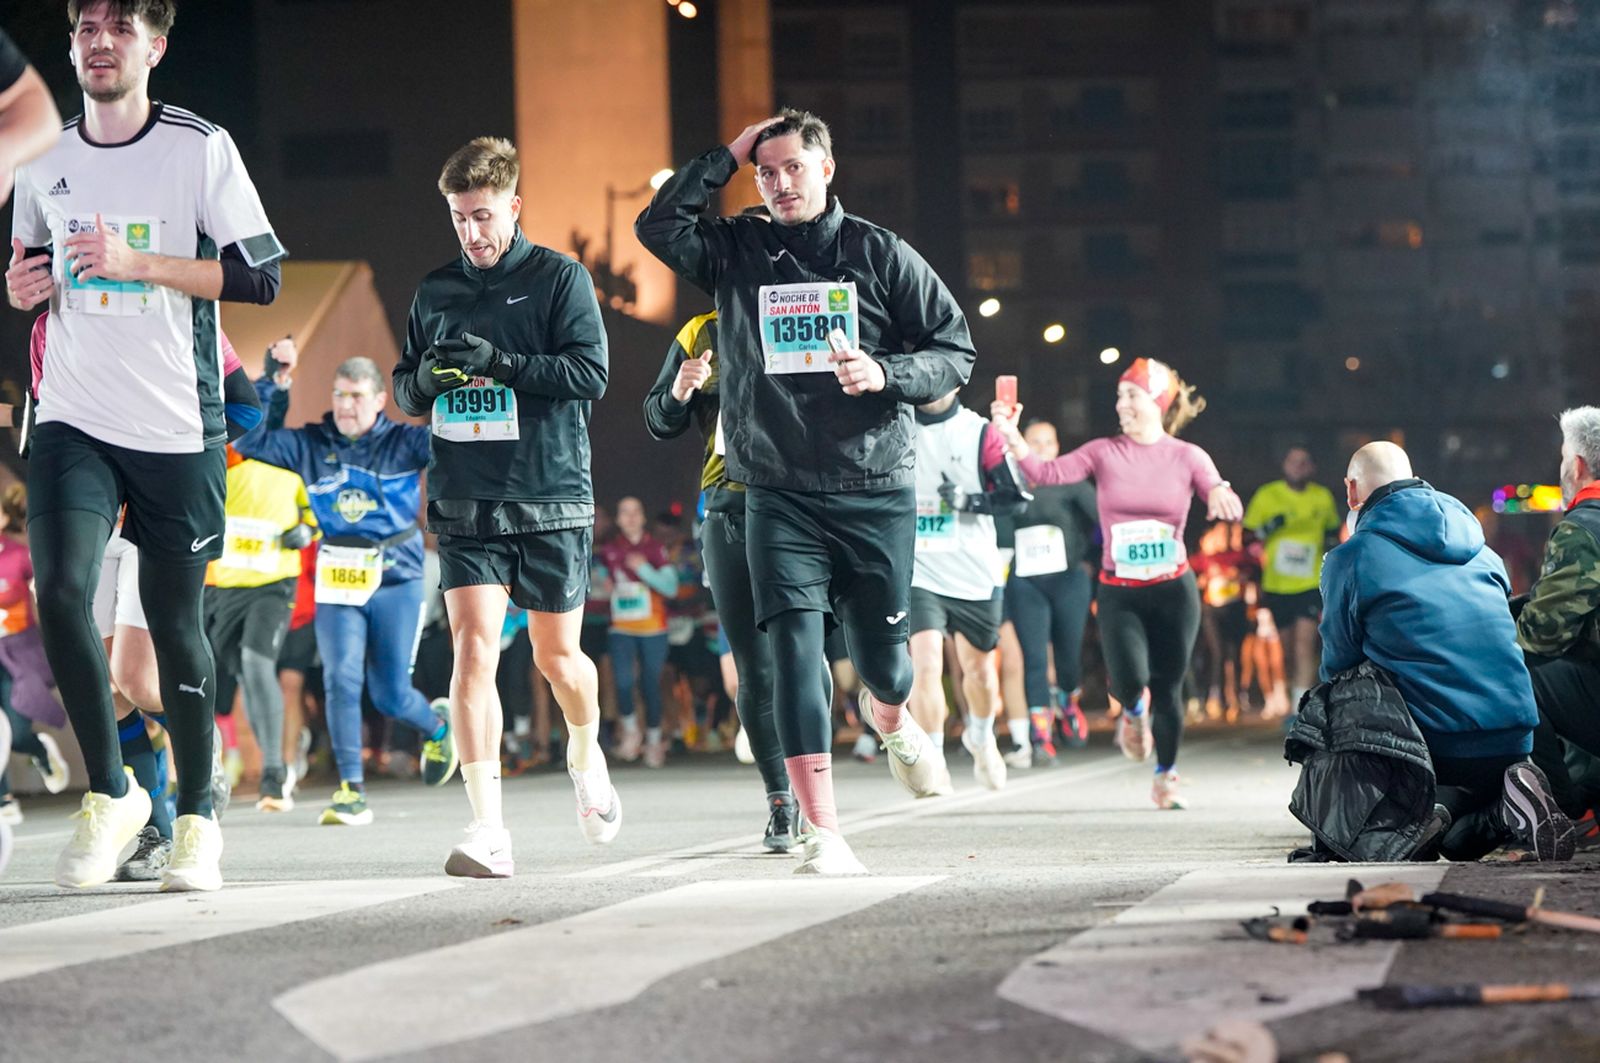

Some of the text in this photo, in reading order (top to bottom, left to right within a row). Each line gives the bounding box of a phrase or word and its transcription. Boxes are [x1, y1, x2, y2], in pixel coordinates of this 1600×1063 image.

[779, 294, 807, 304] NOCHE
[808, 293, 820, 302] DE
[769, 305, 787, 315] SAN
[789, 302, 821, 314] ANTÓN
[443, 388, 507, 414] 13991
[1128, 542, 1165, 561] 8311
[332, 567, 367, 585] 1864
